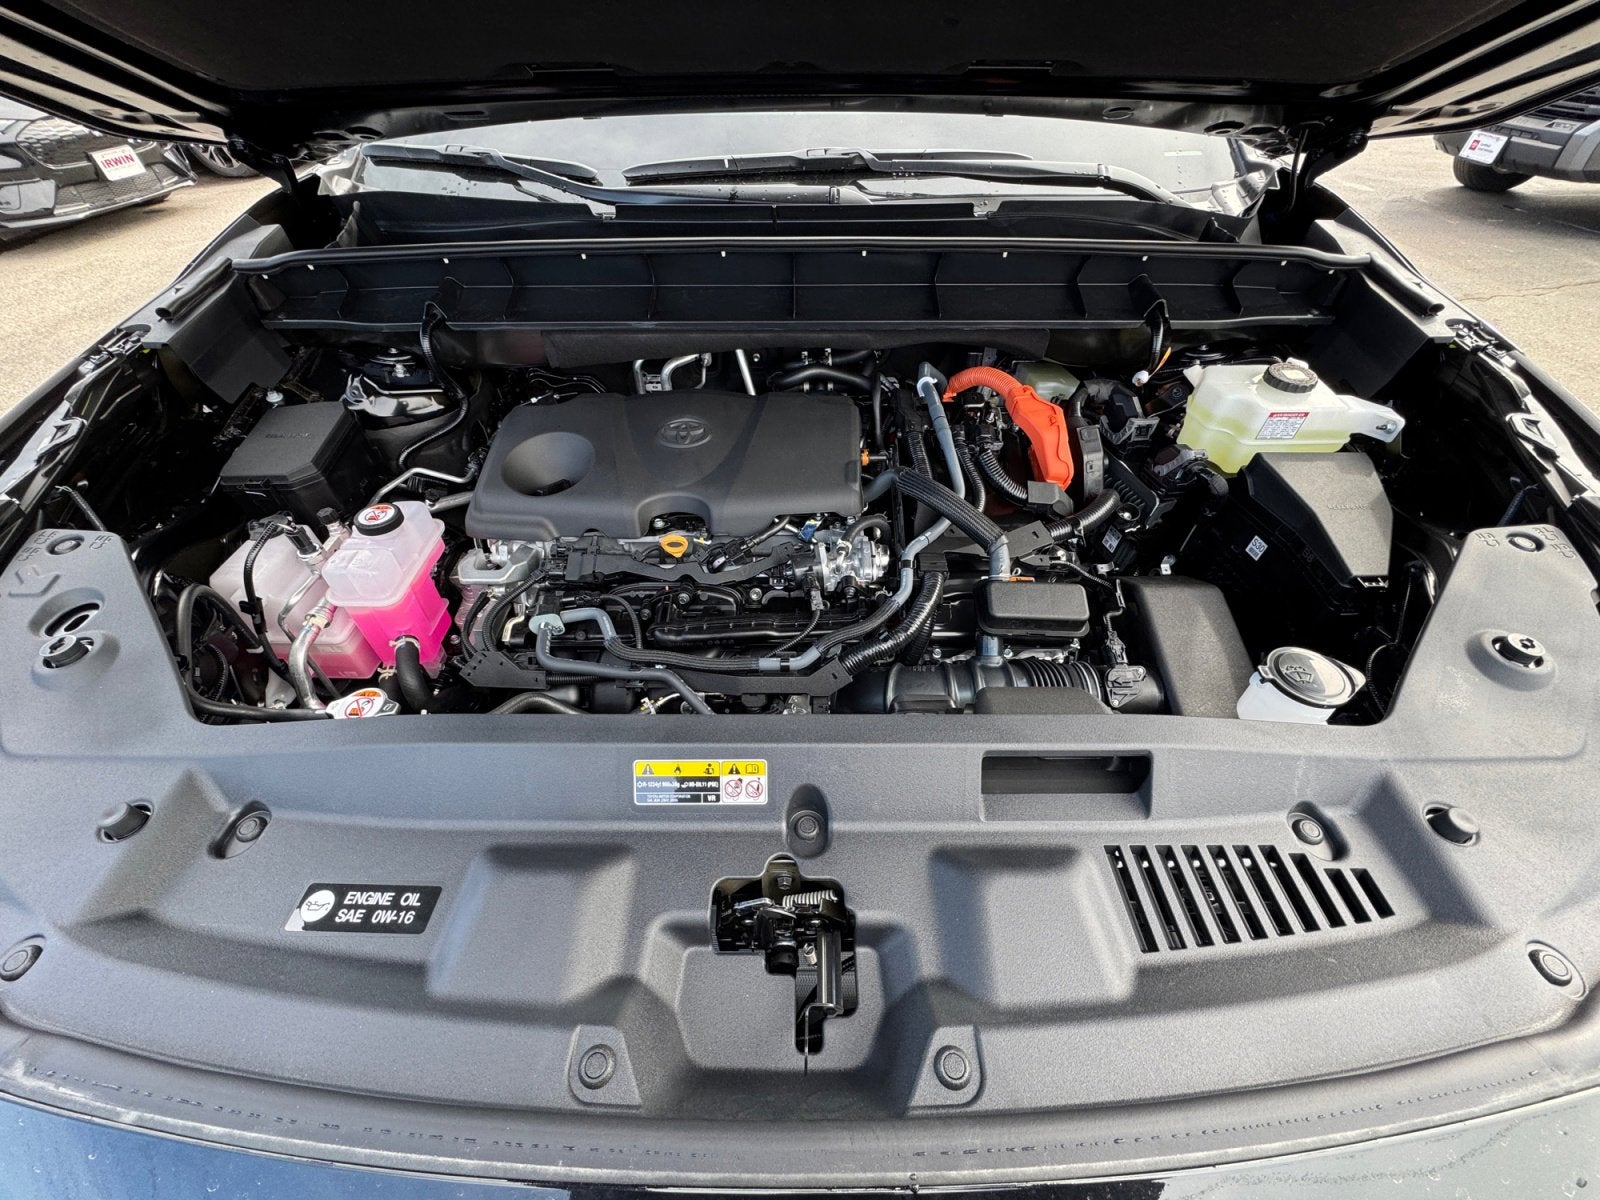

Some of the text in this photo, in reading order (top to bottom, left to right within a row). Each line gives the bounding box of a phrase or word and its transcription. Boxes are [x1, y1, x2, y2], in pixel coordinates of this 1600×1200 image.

[101, 153, 135, 169] IRWIN
[1251, 538, 1266, 553] S30
[707, 794, 717, 802] VR
[343, 891, 422, 906] ENGINE OIL
[335, 908, 415, 924] SAE 0W-16
